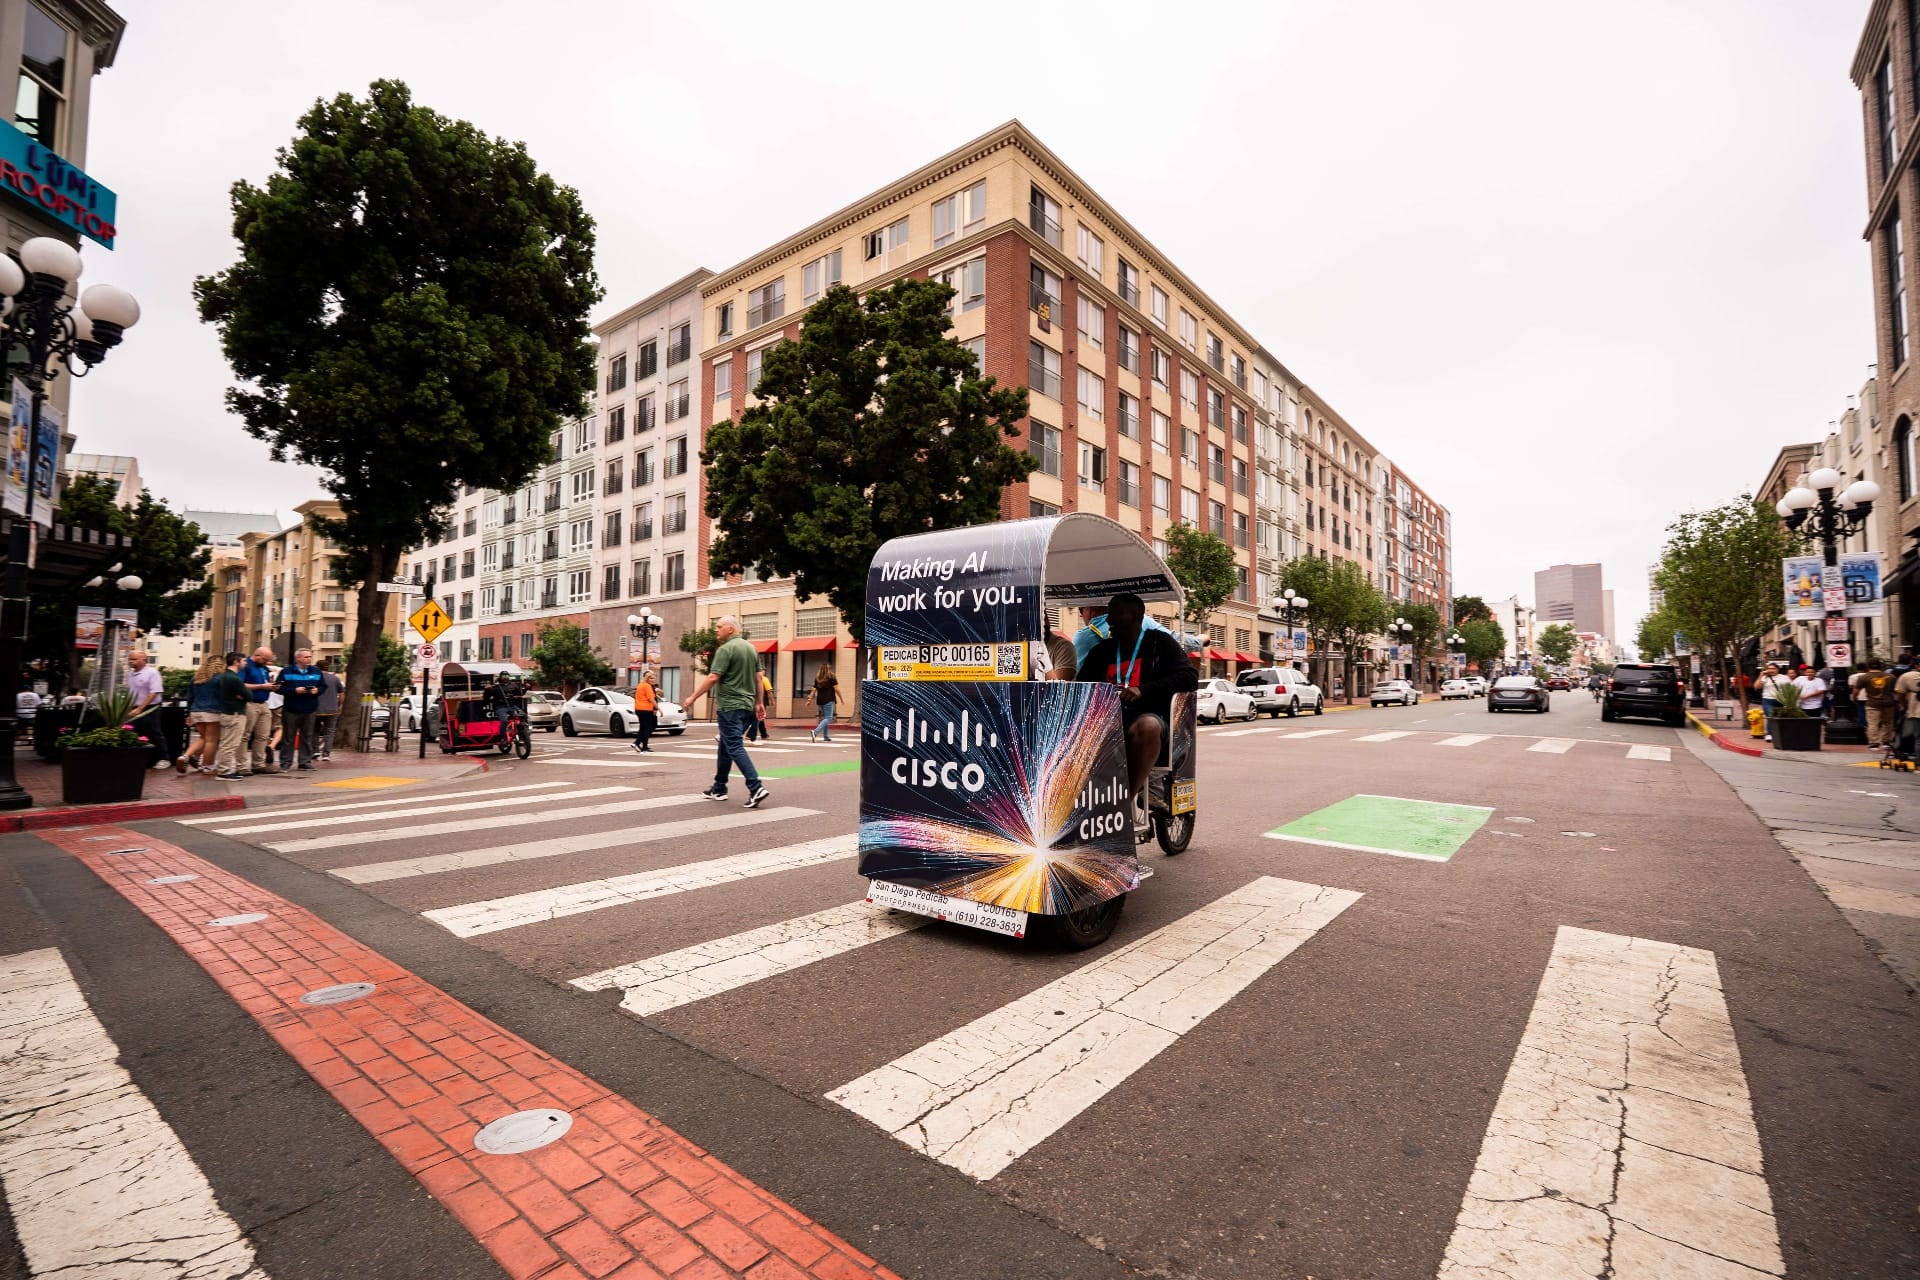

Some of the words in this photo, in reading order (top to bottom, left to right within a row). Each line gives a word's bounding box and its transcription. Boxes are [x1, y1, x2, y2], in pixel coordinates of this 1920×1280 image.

[0, 158, 117, 241] ROOFTOP
[881, 557, 955, 581] Making
[961, 551, 988, 574] AI
[878, 587, 927, 613] work
[934, 586, 965, 610] for
[972, 585, 1023, 612] you.
[884, 650, 918, 661] PEDICAB
[921, 647, 929, 662] S
[932, 646, 948, 662] PC
[951, 645, 990, 662] 00165
[891, 757, 985, 792] CISCO
[1079, 811, 1124, 840] CISCO
[875, 881, 889, 892] San
[891, 884, 914, 899] Diego
[915, 890, 949, 905] Pedicab
[955, 910, 978, 924] (619)
[979, 916, 1022, 933] 228-3632
[976, 902, 1017, 919] PC00165
